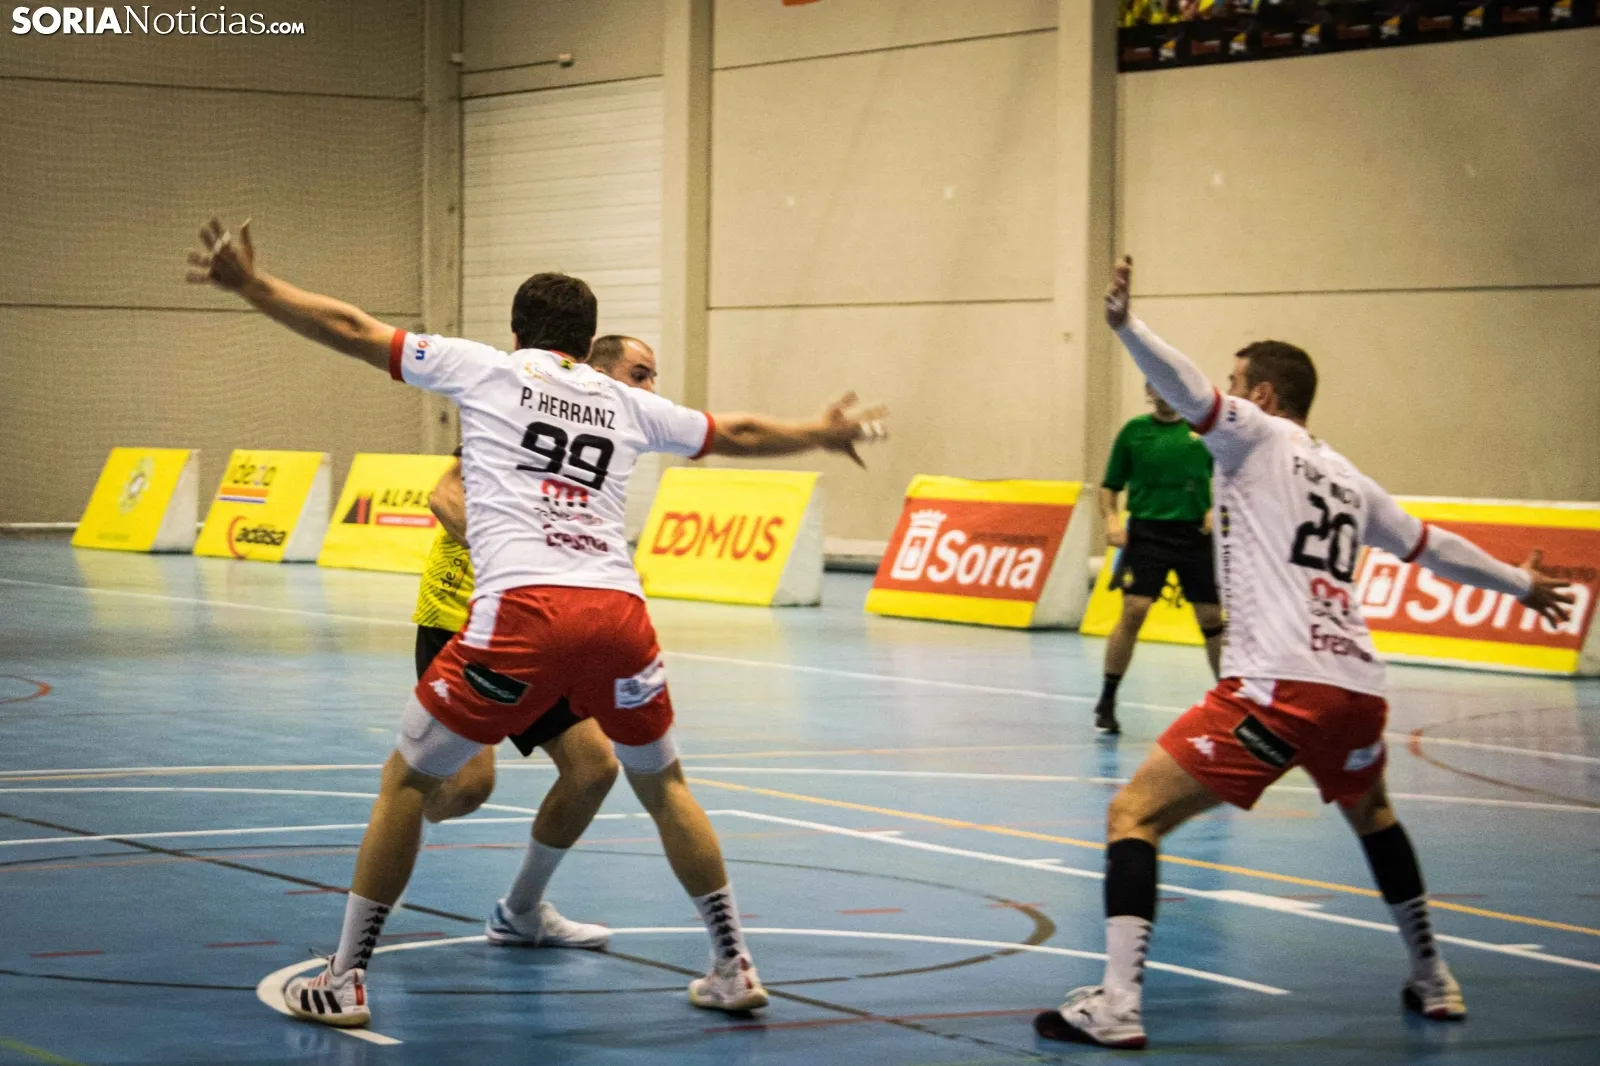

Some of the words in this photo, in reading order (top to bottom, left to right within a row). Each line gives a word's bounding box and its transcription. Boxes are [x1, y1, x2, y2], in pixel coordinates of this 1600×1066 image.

[520, 386, 533, 409] P.
[538, 392, 616, 430] HERRANZ
[516, 421, 615, 491] 99
[650, 511, 784, 562] DOMUS
[926, 529, 1044, 590] Soria
[1288, 492, 1360, 583] 20
